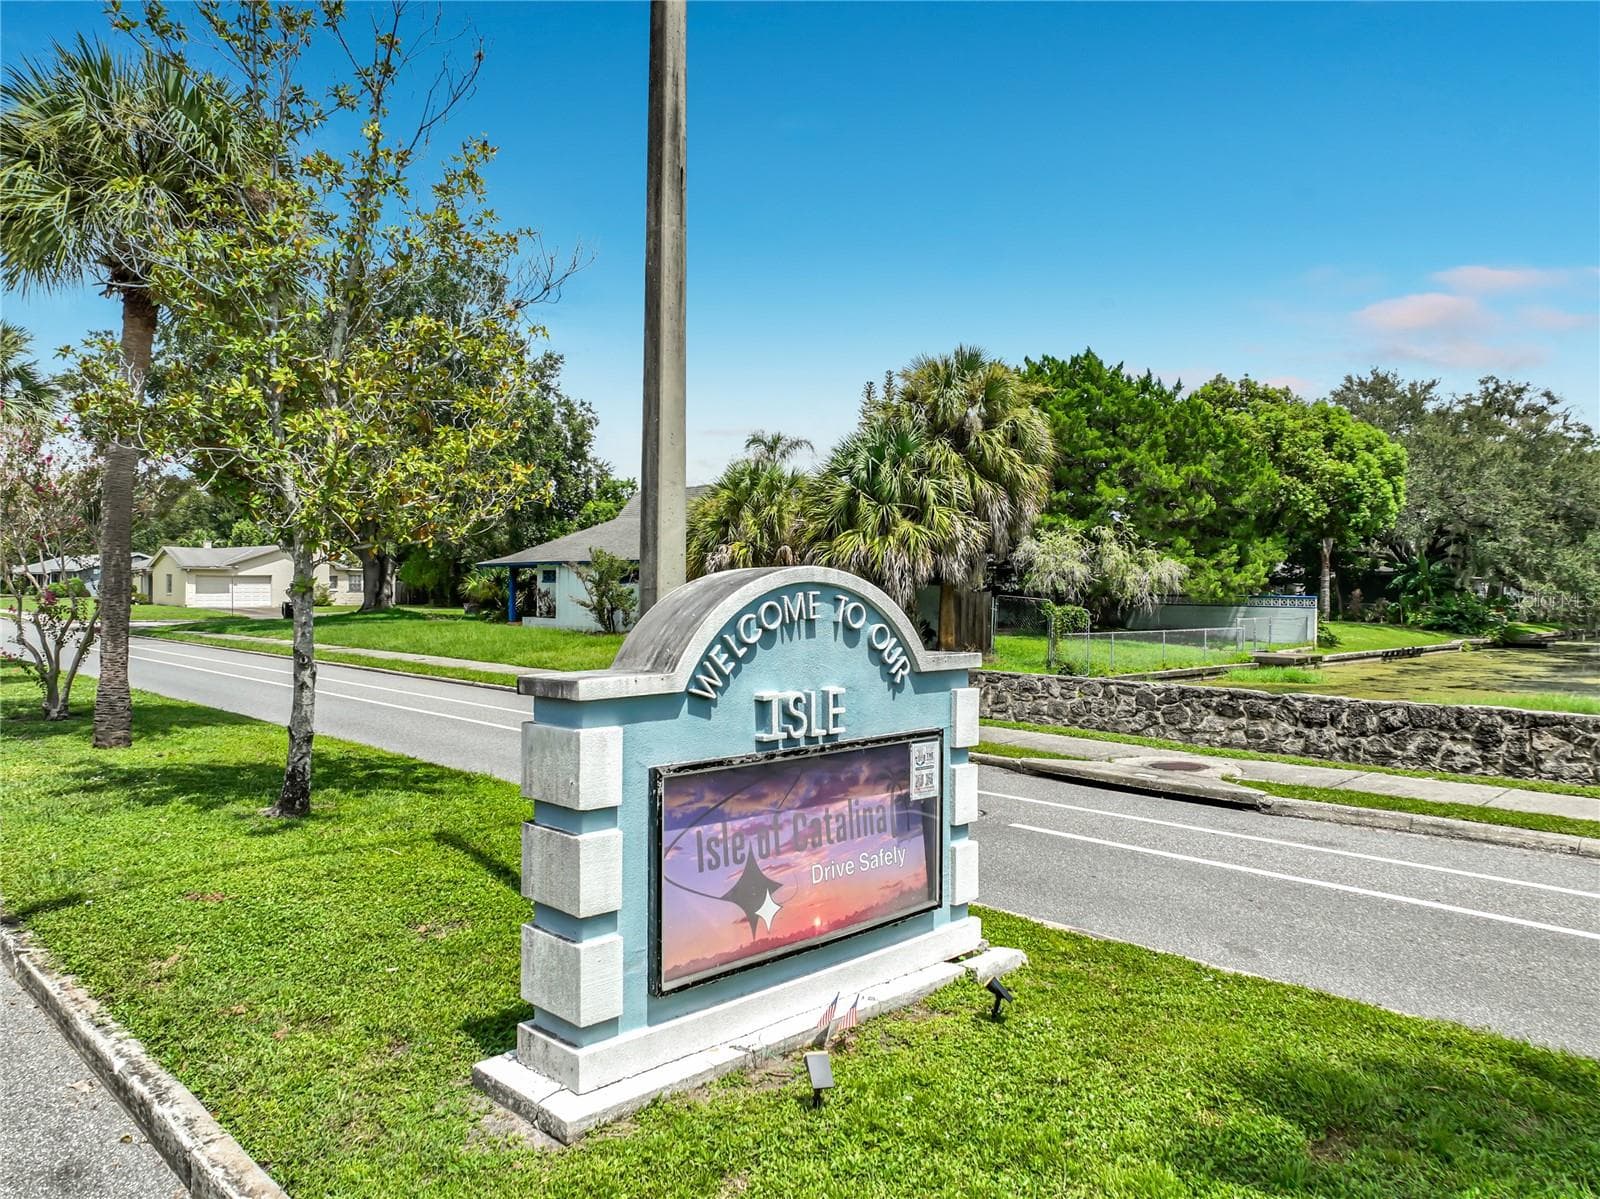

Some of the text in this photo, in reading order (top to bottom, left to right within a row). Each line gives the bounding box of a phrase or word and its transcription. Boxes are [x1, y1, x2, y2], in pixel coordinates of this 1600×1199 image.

[689, 591, 910, 699] WELCOME TO OUR
[754, 687, 846, 741] ISLE
[696, 797, 885, 873] Isle of Catalina
[811, 846, 906, 885] Drive Safely
